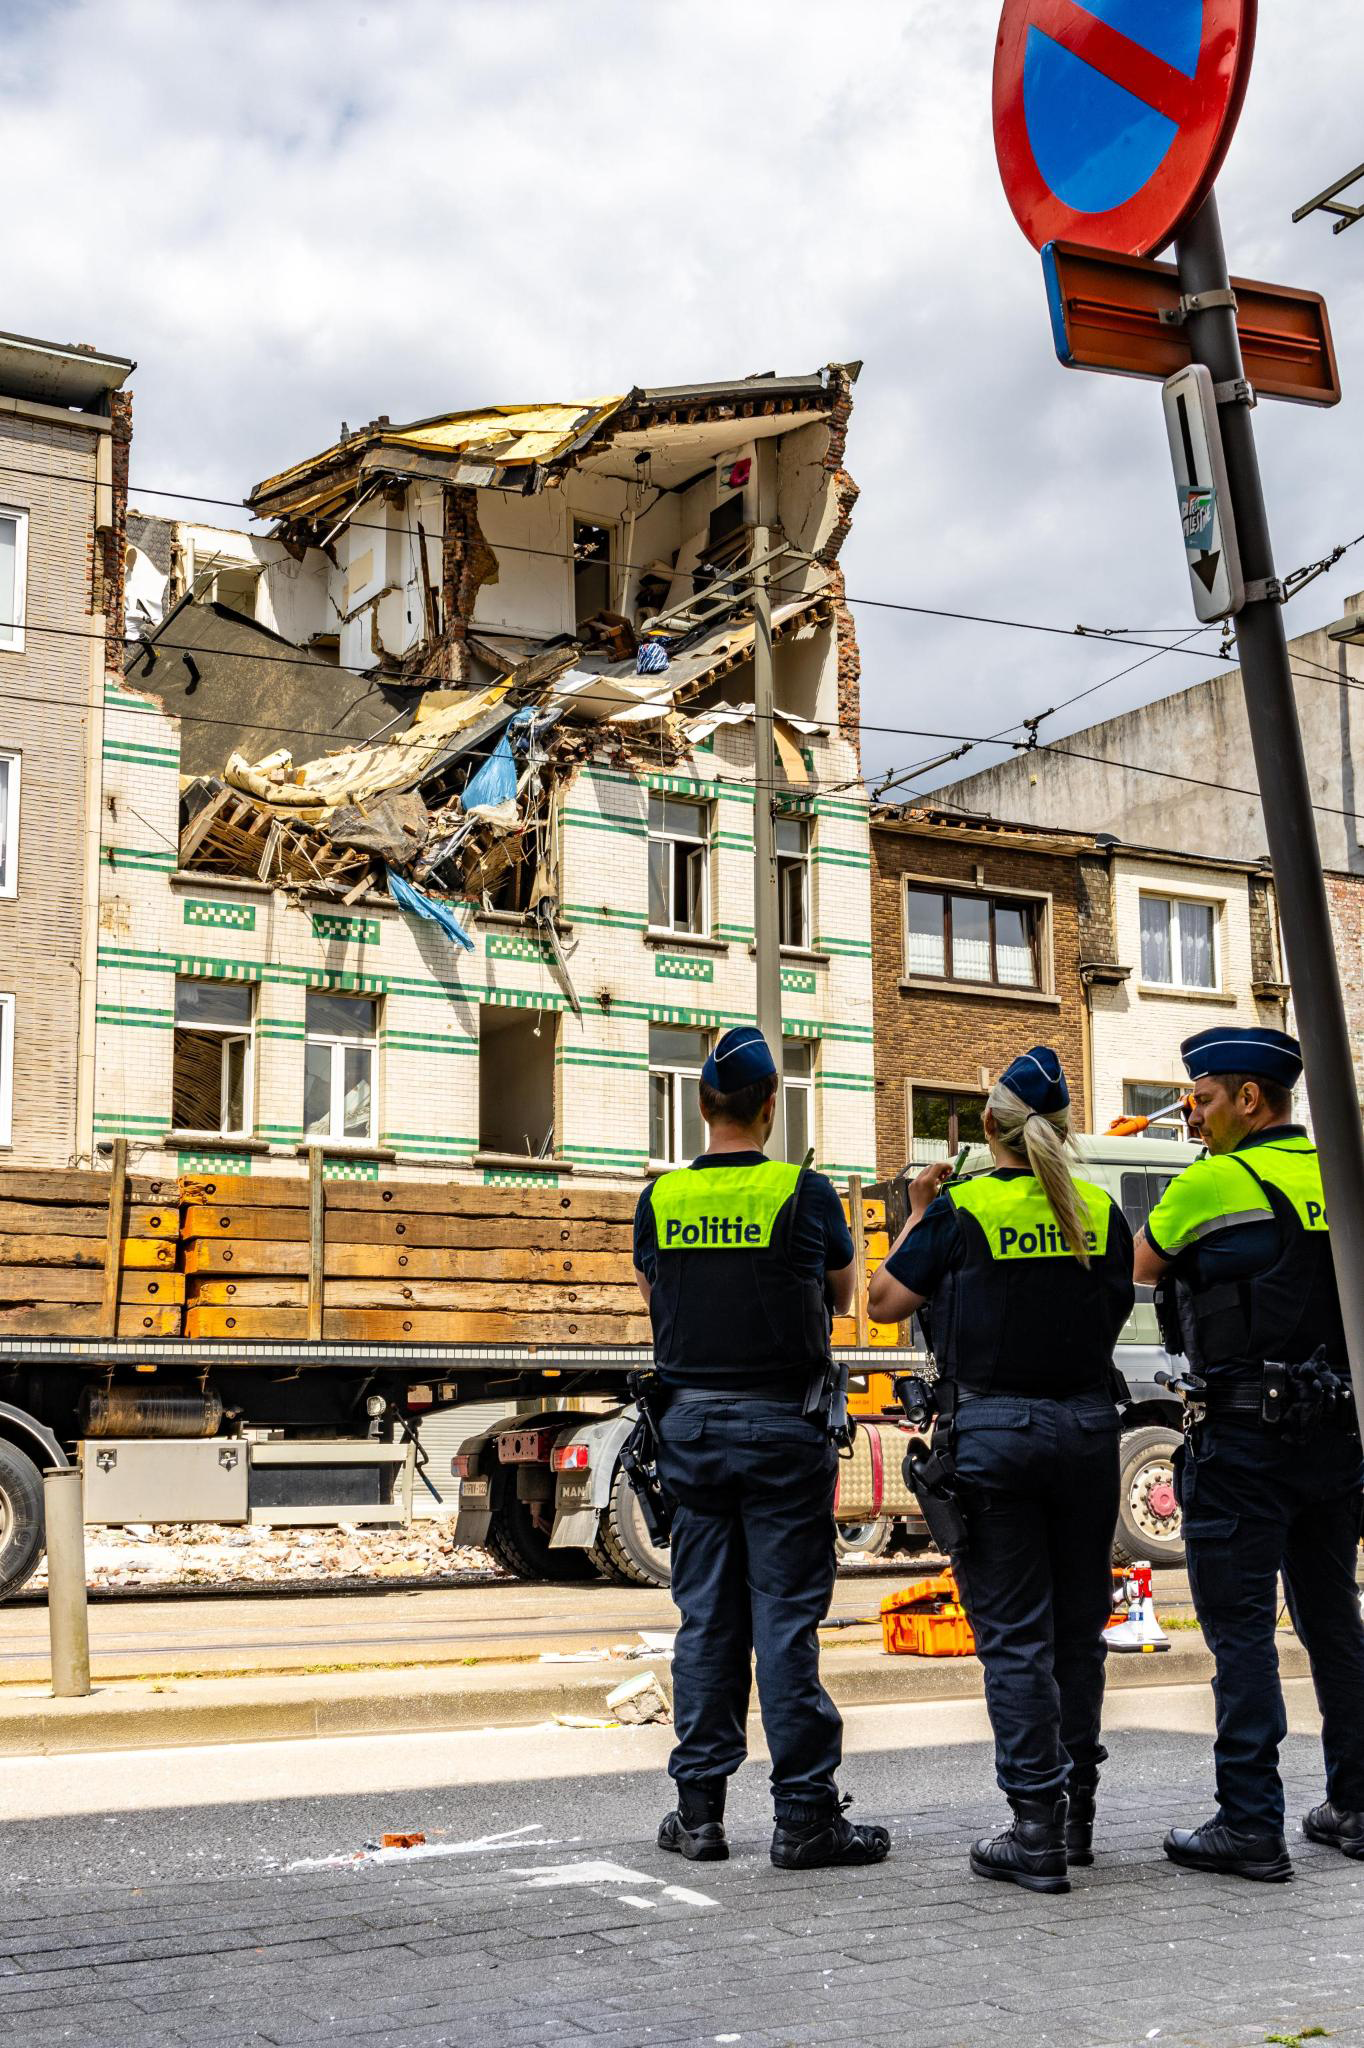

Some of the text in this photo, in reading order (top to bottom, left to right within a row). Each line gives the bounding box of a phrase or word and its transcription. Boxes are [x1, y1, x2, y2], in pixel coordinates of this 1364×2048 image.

[666, 1216, 761, 1245] Politie
[999, 1223, 1097, 1254] Polite
[562, 1486, 585, 1497] MAN
